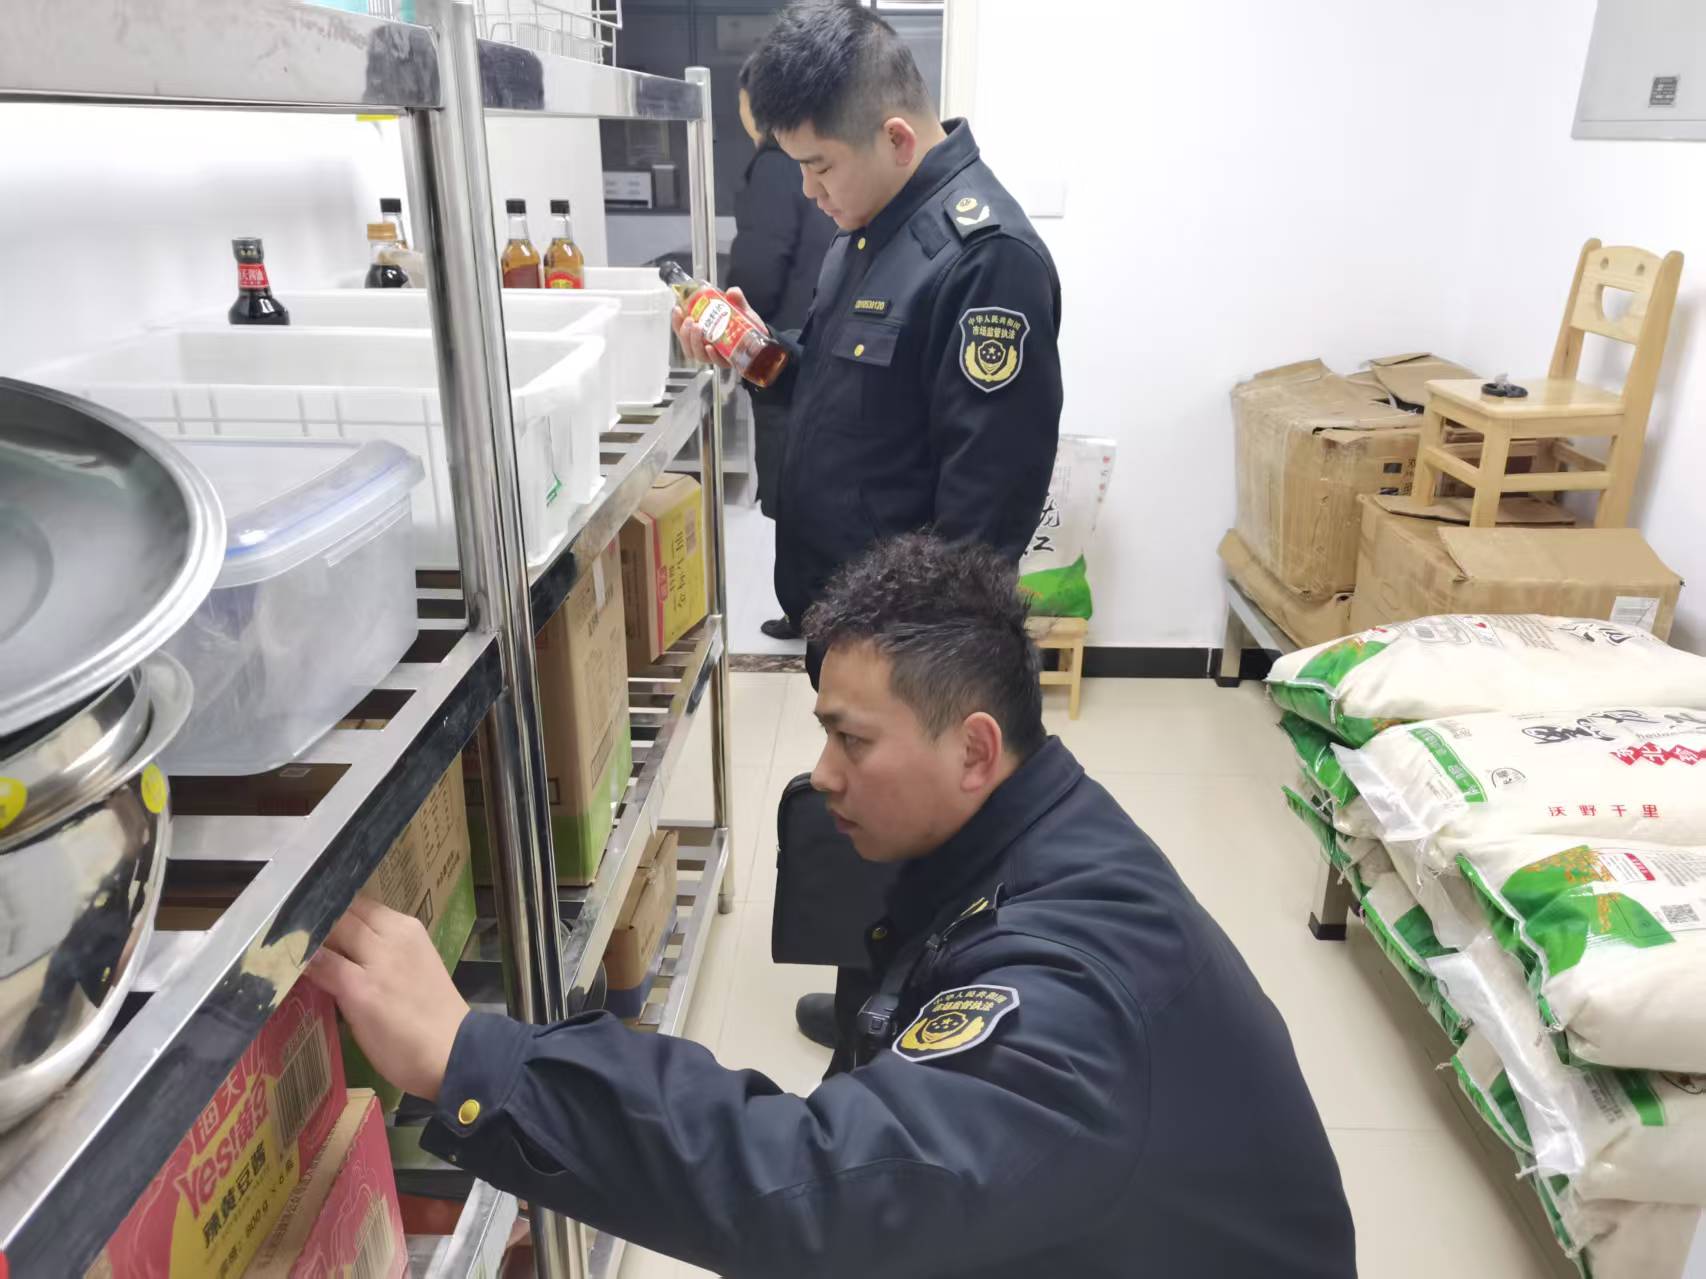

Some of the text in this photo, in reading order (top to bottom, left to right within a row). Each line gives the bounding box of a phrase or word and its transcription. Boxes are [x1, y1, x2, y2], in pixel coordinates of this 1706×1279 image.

[968, 314, 1021, 330] 中华人民共和国
[972, 325, 1015, 340] 市场监管执法
[1547, 803, 1660, 819] 沃野千里
